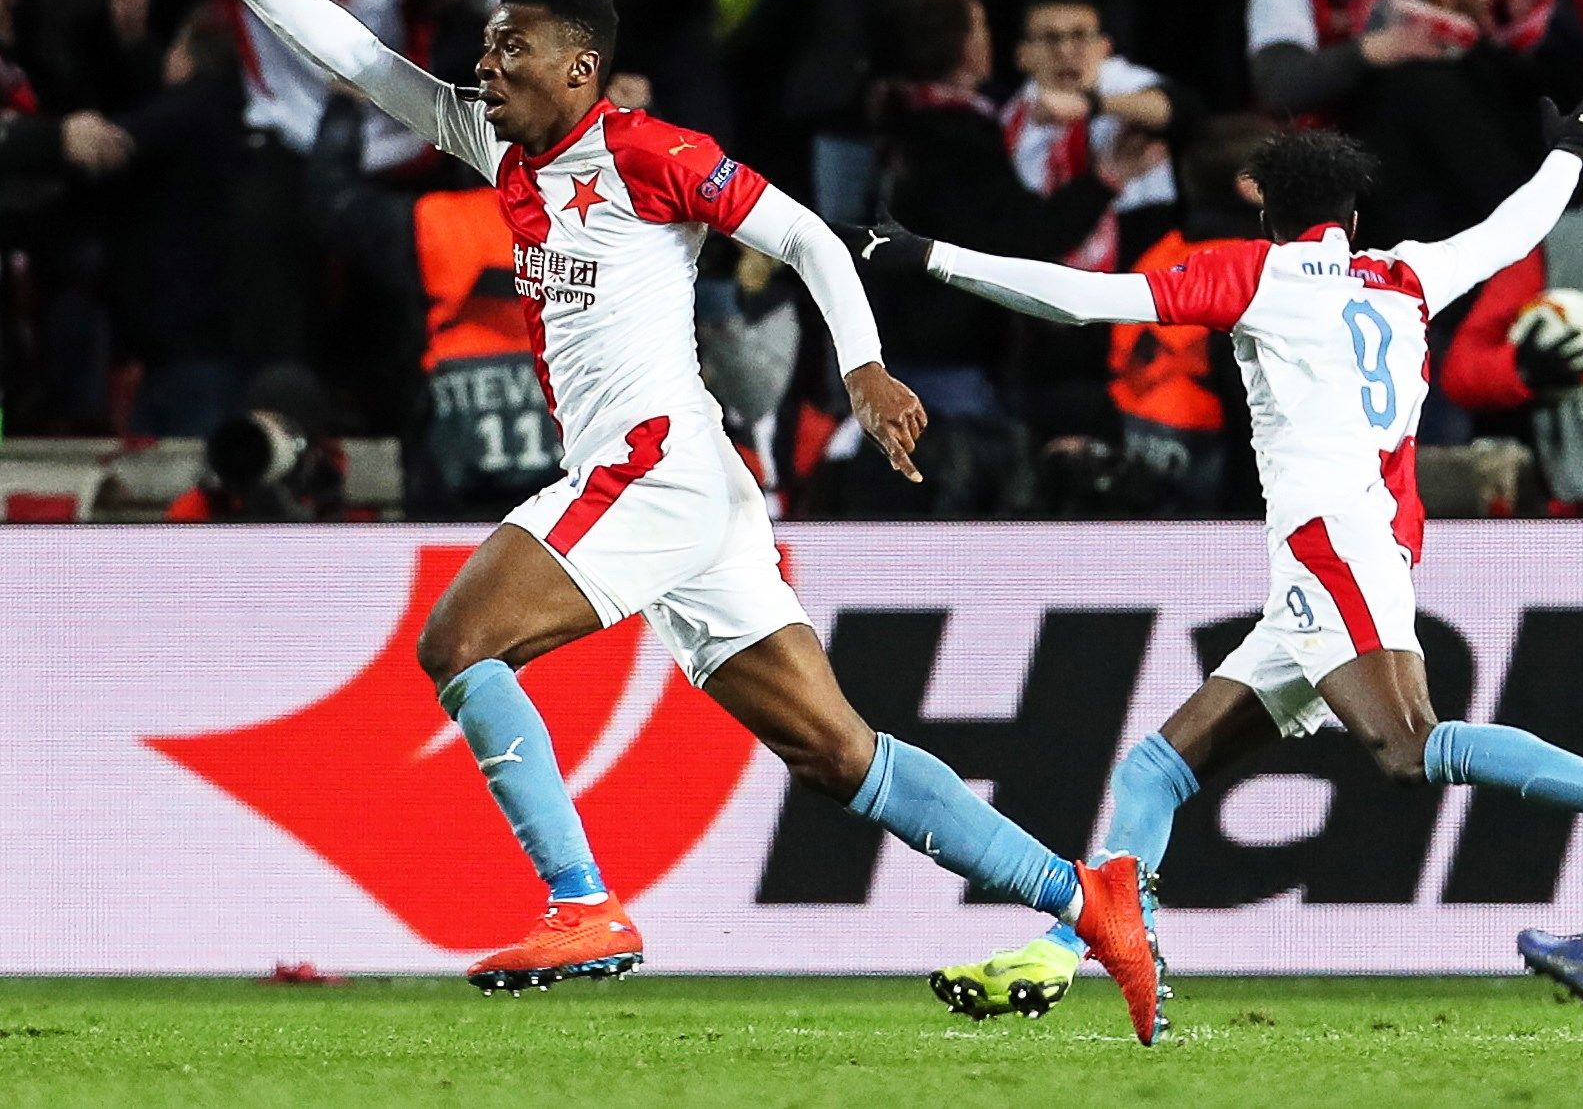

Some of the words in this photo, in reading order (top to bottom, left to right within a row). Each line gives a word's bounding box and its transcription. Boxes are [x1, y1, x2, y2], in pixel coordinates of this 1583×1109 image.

[543, 285, 596, 311] Group
[430, 363, 547, 418] STEW
[1342, 298, 1397, 430] 9
[475, 410, 564, 472] 11
[1287, 585, 1315, 629] 9
